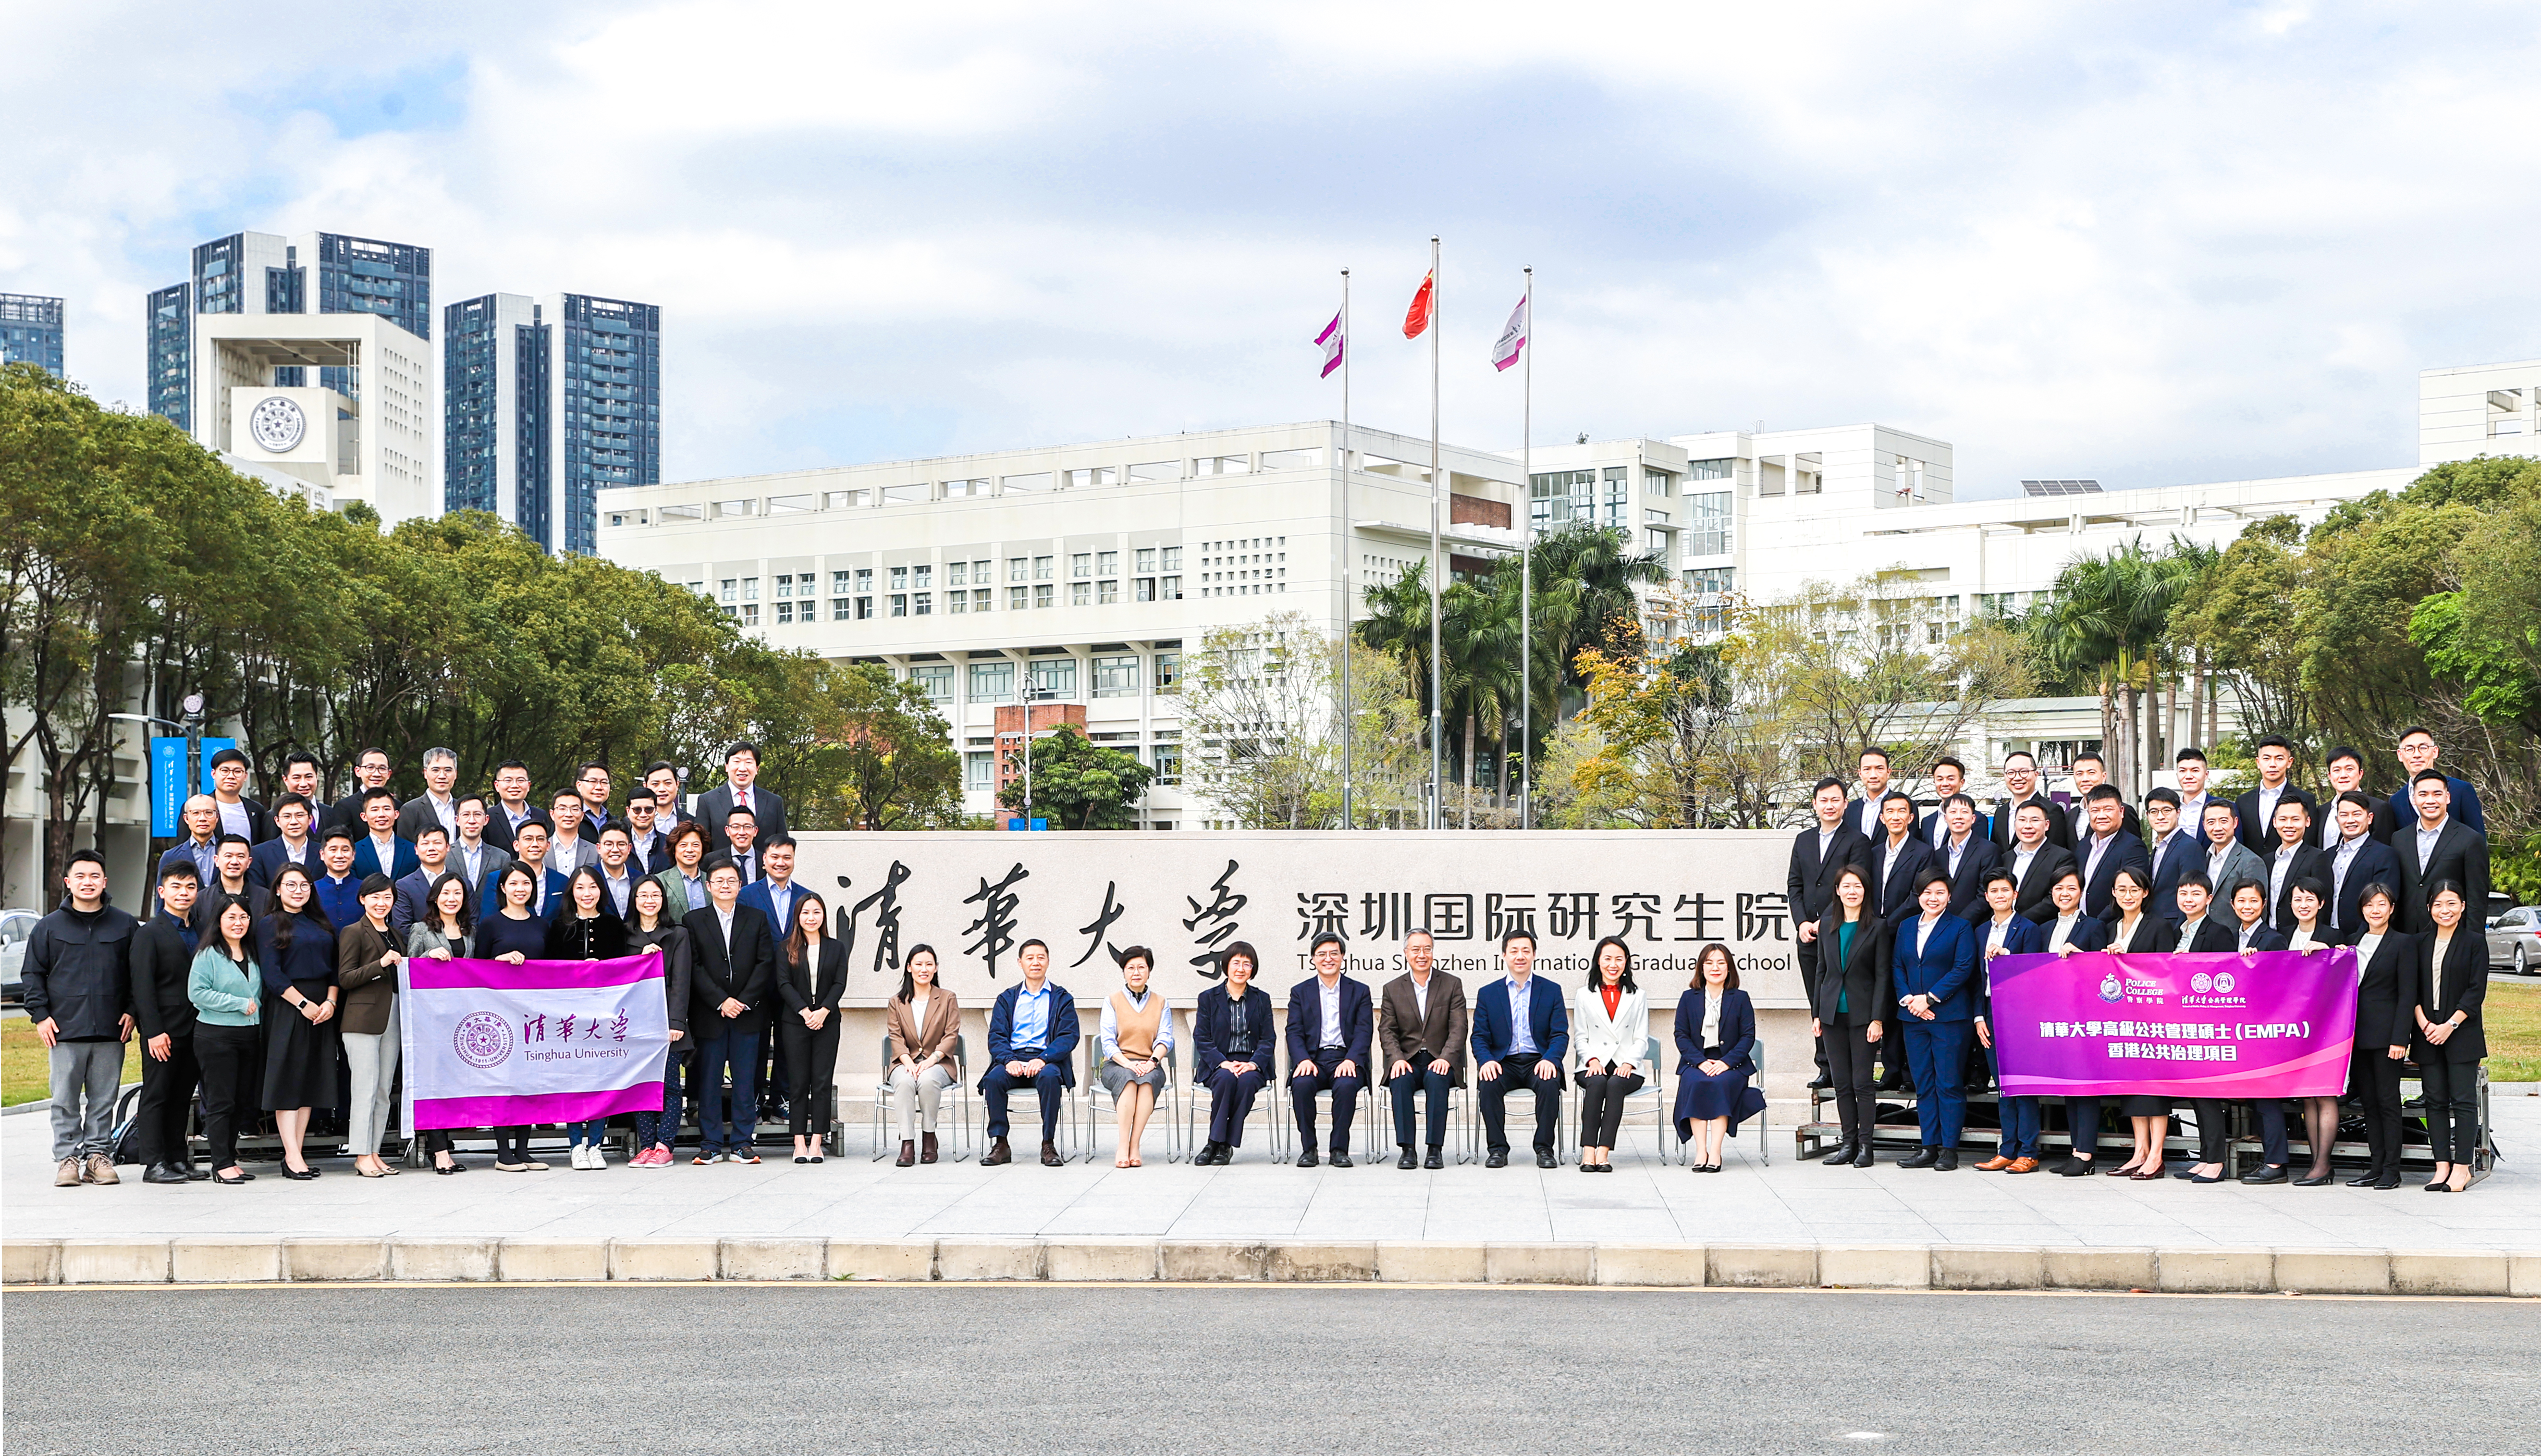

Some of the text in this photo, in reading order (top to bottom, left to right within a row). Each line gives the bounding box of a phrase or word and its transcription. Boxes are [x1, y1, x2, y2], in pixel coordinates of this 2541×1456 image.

[1297, 892, 1789, 941] 深圳国际研究生院
[1629, 953, 1697, 970] Gradua
[2125, 978, 2157, 987] POLICE
[2126, 986, 2164, 996] COLLEGE
[524, 1047, 630, 1062] Tsinghua University
[2107, 1042, 2238, 1062] 香港公共治理項目
